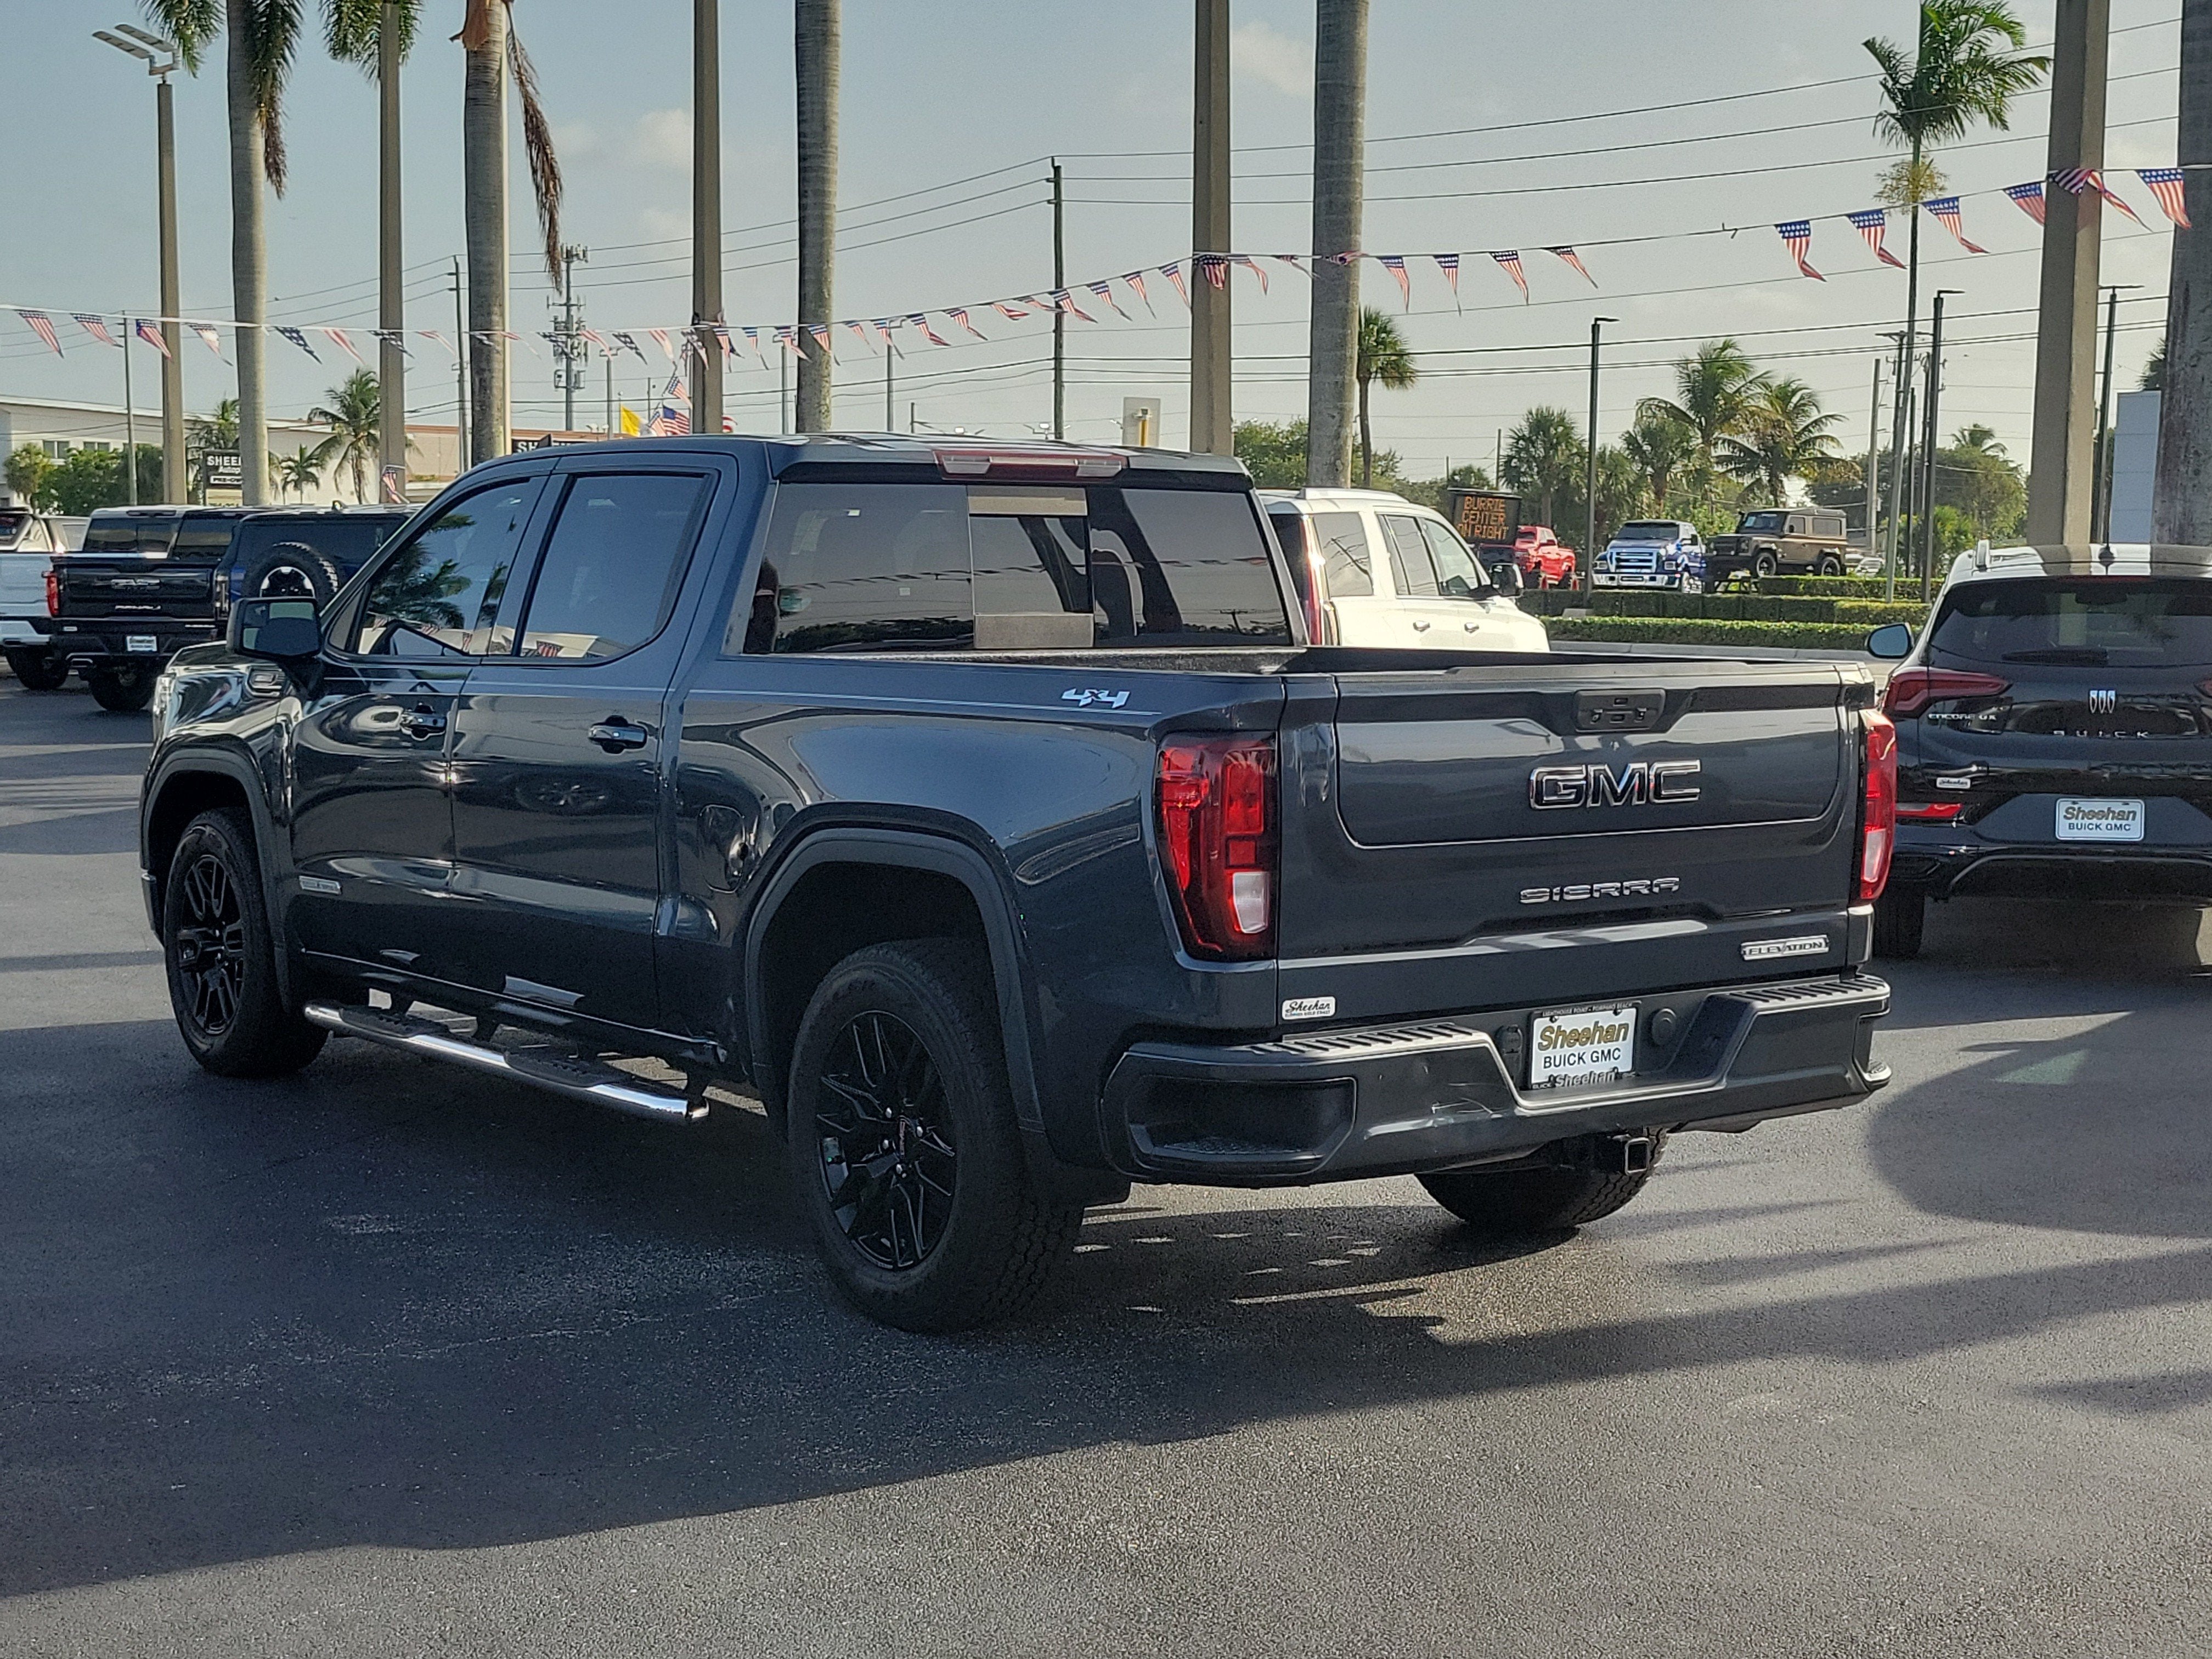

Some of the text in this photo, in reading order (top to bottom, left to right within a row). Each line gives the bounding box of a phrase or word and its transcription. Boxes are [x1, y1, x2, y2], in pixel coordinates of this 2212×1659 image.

[1462, 510, 1506, 526] CENTER
[1475, 525, 1509, 540] RIGHT
[1530, 759, 1700, 809] GMC
[2063, 806, 2137, 821] Sheehan
[1520, 877, 1679, 904] SIERRA
[1748, 941, 1822, 955] ELEVATION
[1285, 1000, 1330, 1013] Sheehan
[1538, 1020, 1629, 1051] Sheehan
[1543, 1047, 1621, 1069] BUICK GMC
[1555, 1070, 1615, 1088] Sheehan
